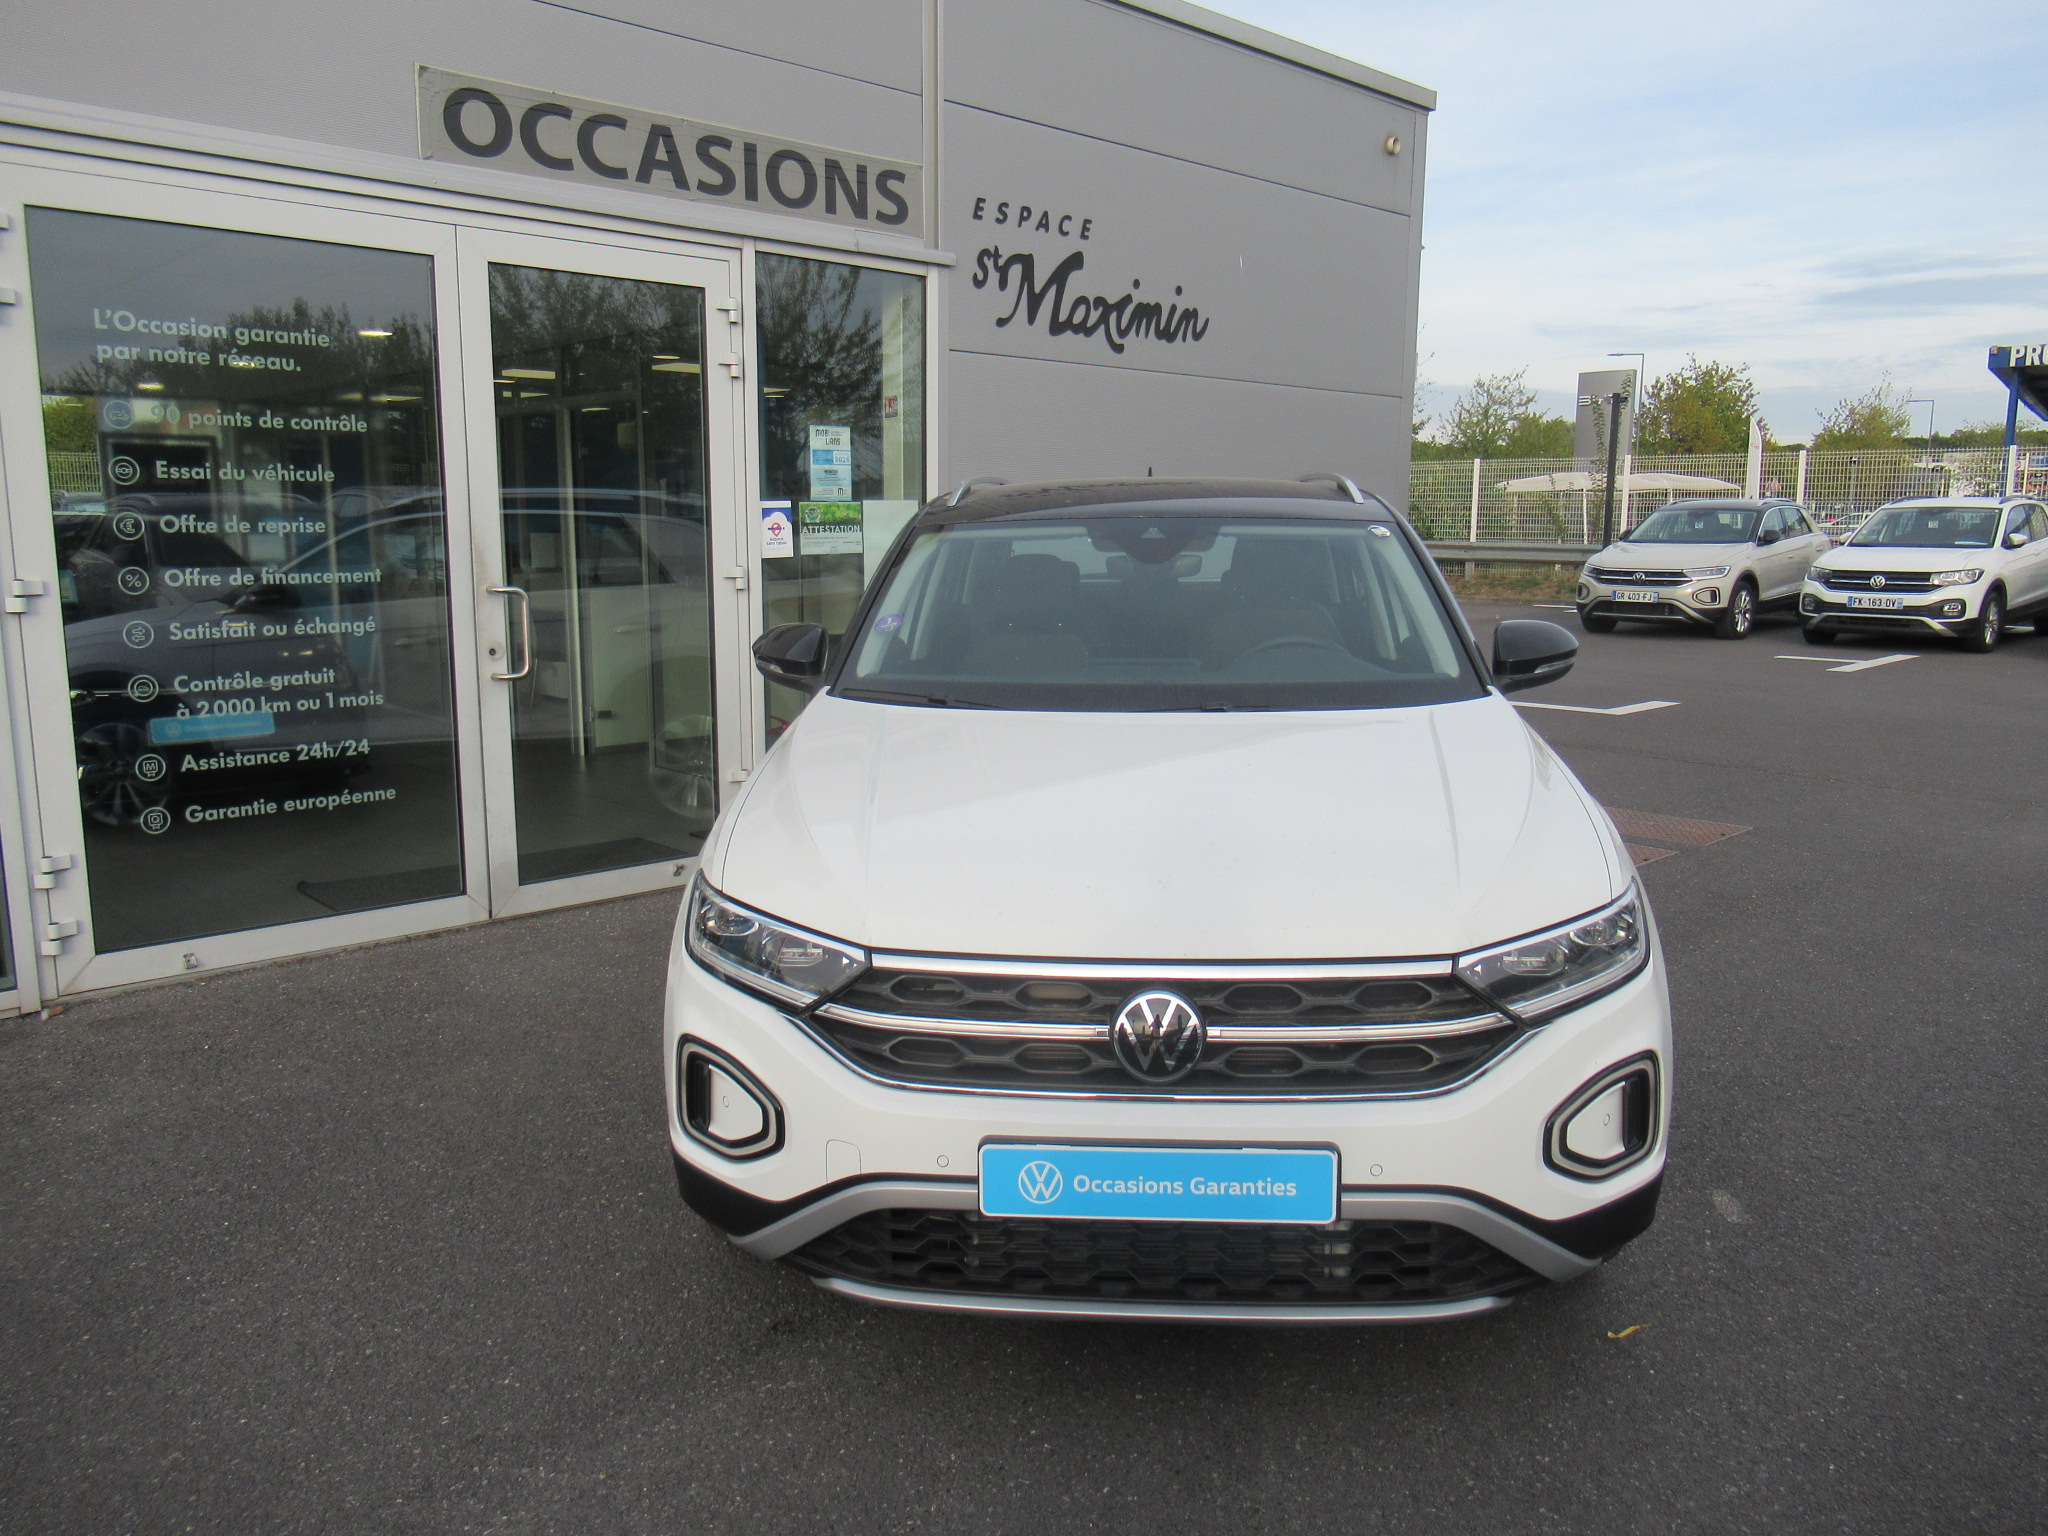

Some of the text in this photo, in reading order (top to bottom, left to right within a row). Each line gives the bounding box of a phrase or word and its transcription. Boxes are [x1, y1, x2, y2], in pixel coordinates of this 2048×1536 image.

[442, 86, 909, 225] OCCASIONS
[972, 197, 1093, 240] ESPACE
[995, 250, 1209, 354] Maximin
[93, 308, 330, 348] L'Occasion garantie
[97, 344, 302, 372] par notre réseau.
[151, 405, 368, 433] 90 points de contrôle
[155, 460, 335, 482] Essai du véhicule
[160, 514, 326, 537] Offre de reprise
[801, 524, 861, 534] ATTESTATION
[164, 567, 382, 587] Offre de financement
[169, 616, 376, 640] Satisfait ou échangé
[173, 668, 336, 693] Contrôle gratuit
[176, 702, 190, 720] à
[261, 696, 291, 714] km
[296, 698, 321, 711] ou
[325, 692, 335, 708] 1
[339, 690, 384, 708] mois
[180, 738, 371, 772] Assistance 24h/24
[185, 787, 397, 824] Garantie européenne
[1073, 1174, 1183, 1195] Occasions
[1189, 1176, 1297, 1197] Garanties
